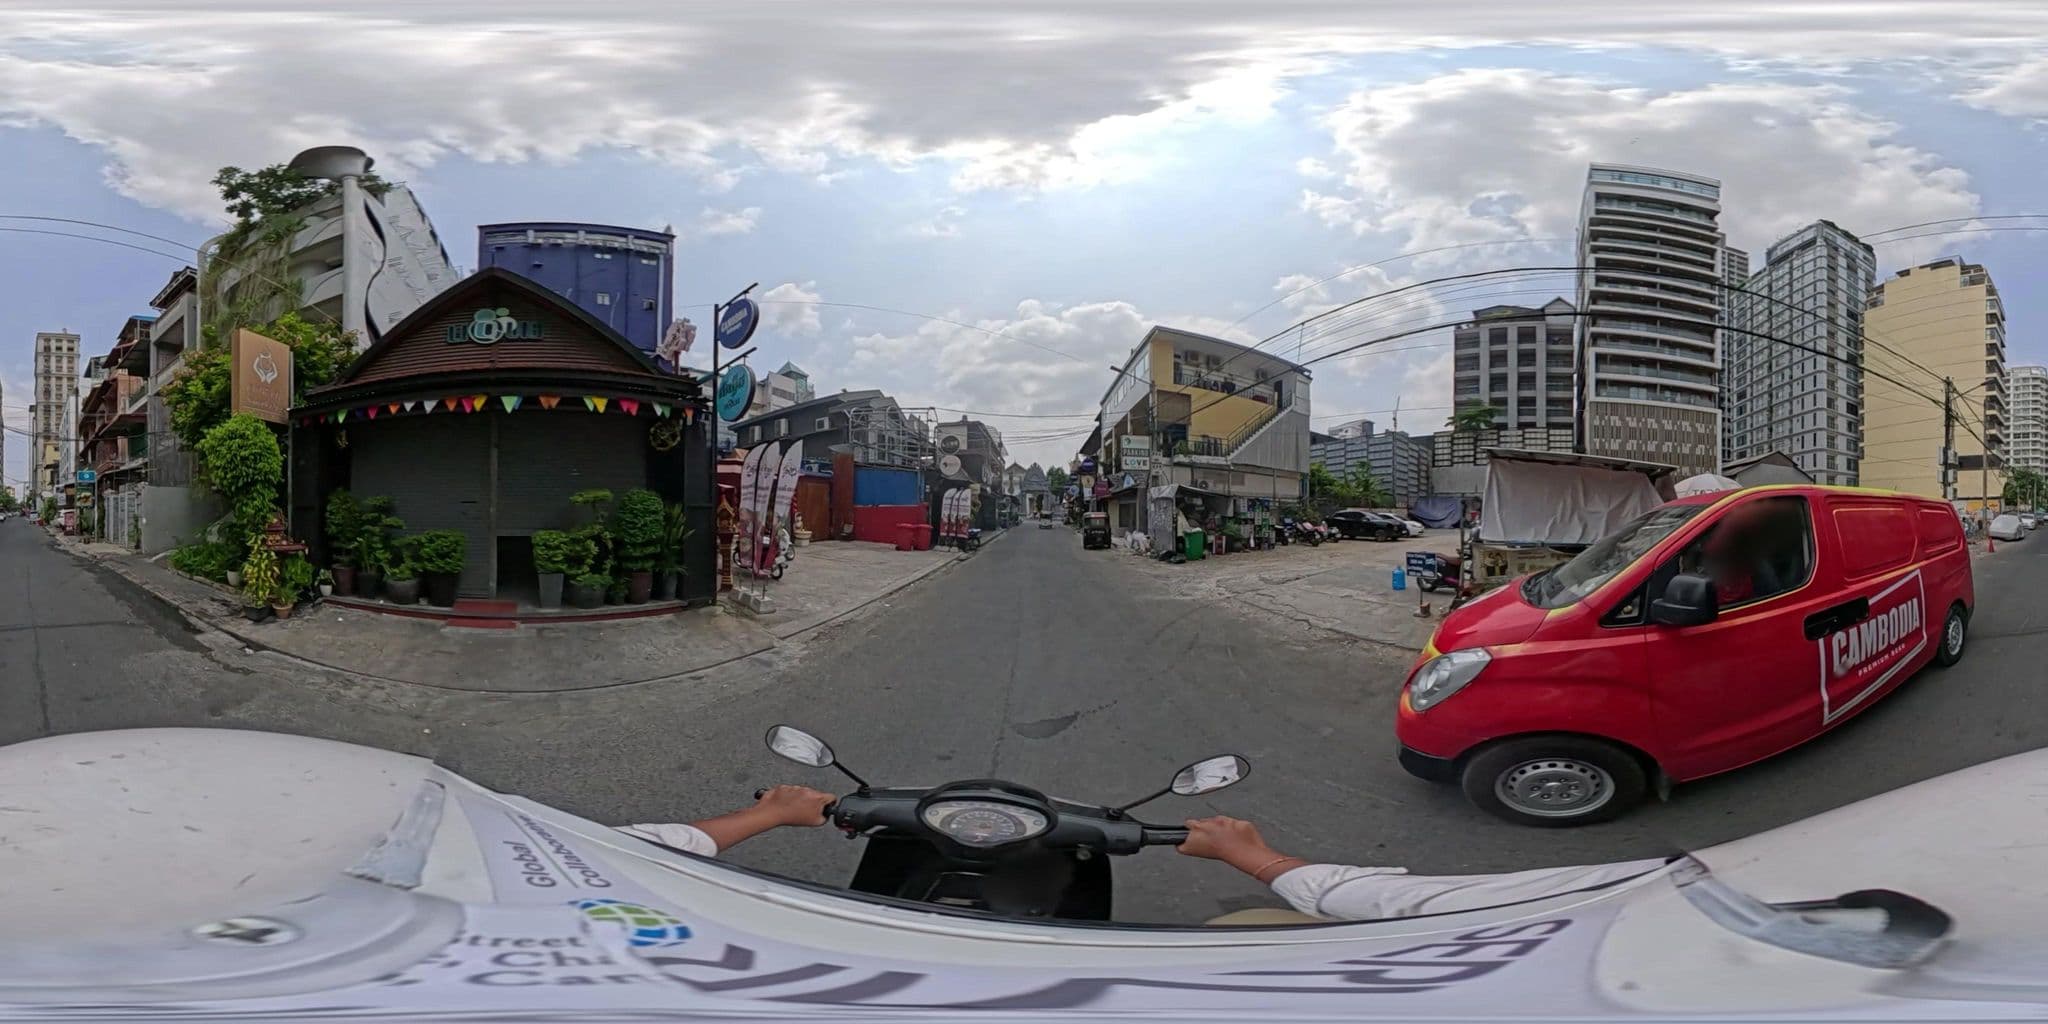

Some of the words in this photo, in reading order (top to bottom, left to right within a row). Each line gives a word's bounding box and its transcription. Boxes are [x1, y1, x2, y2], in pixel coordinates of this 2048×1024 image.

[1832, 598, 1920, 677] CAMBODIA
[1858, 655, 1889, 677] PREMIUM
[503, 841, 556, 888] Global
